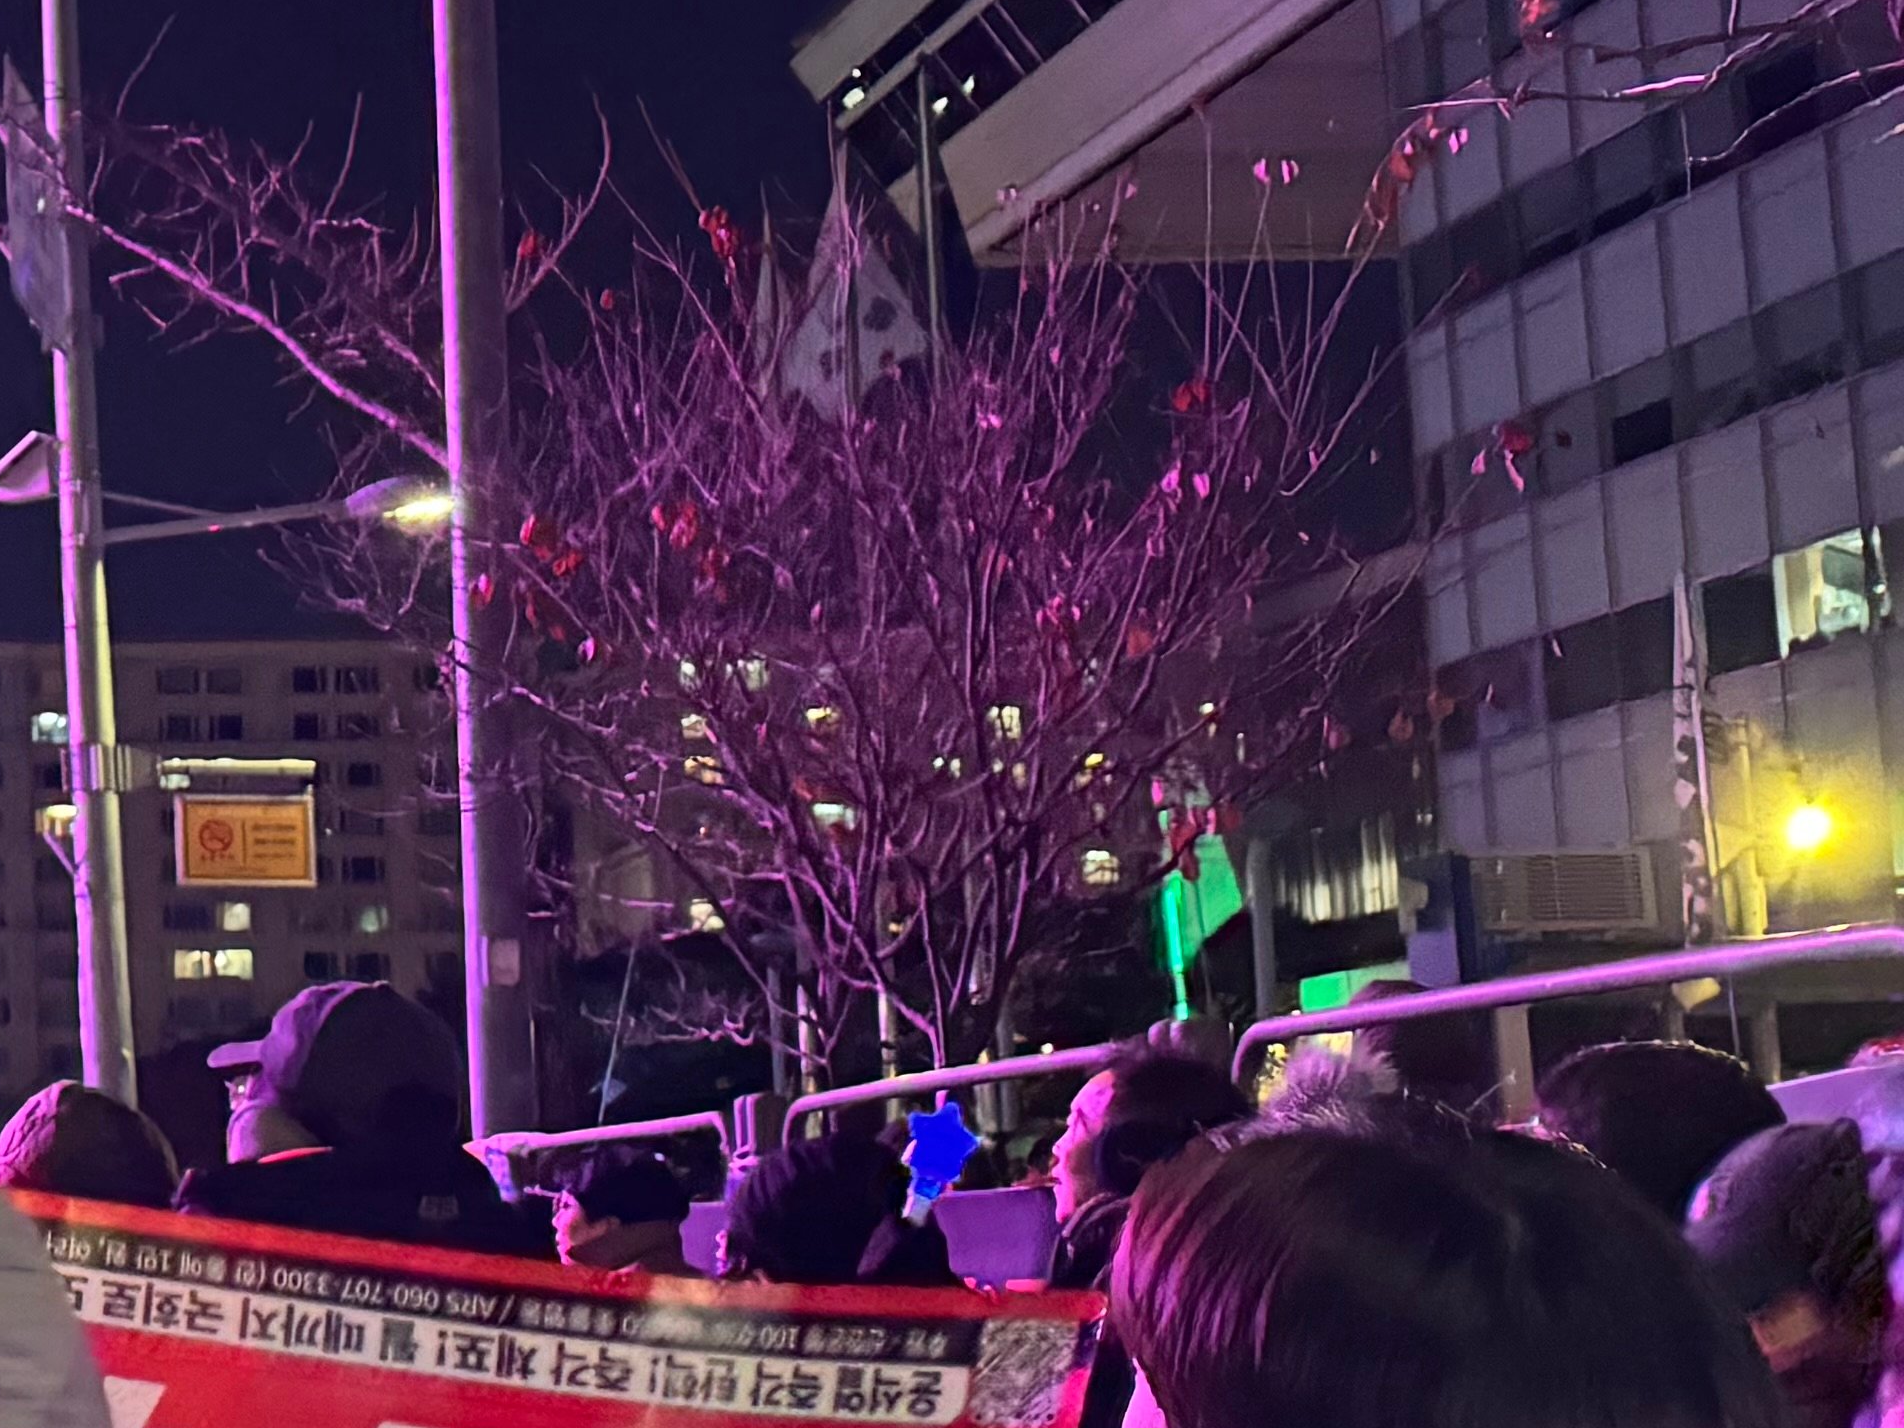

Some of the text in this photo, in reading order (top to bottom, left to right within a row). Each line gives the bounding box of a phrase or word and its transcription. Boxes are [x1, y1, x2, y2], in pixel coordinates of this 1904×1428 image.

[101, 1280, 224, 1335] 국회로
[241, 1296, 364, 1355] 때까지
[438, 1329, 540, 1381] 체포!
[550, 1343, 632, 1394] 즉각
[650, 1353, 737, 1404] 탄핵!
[750, 1358, 822, 1410] 즉각
[833, 1365, 944, 1419] 윤석열
